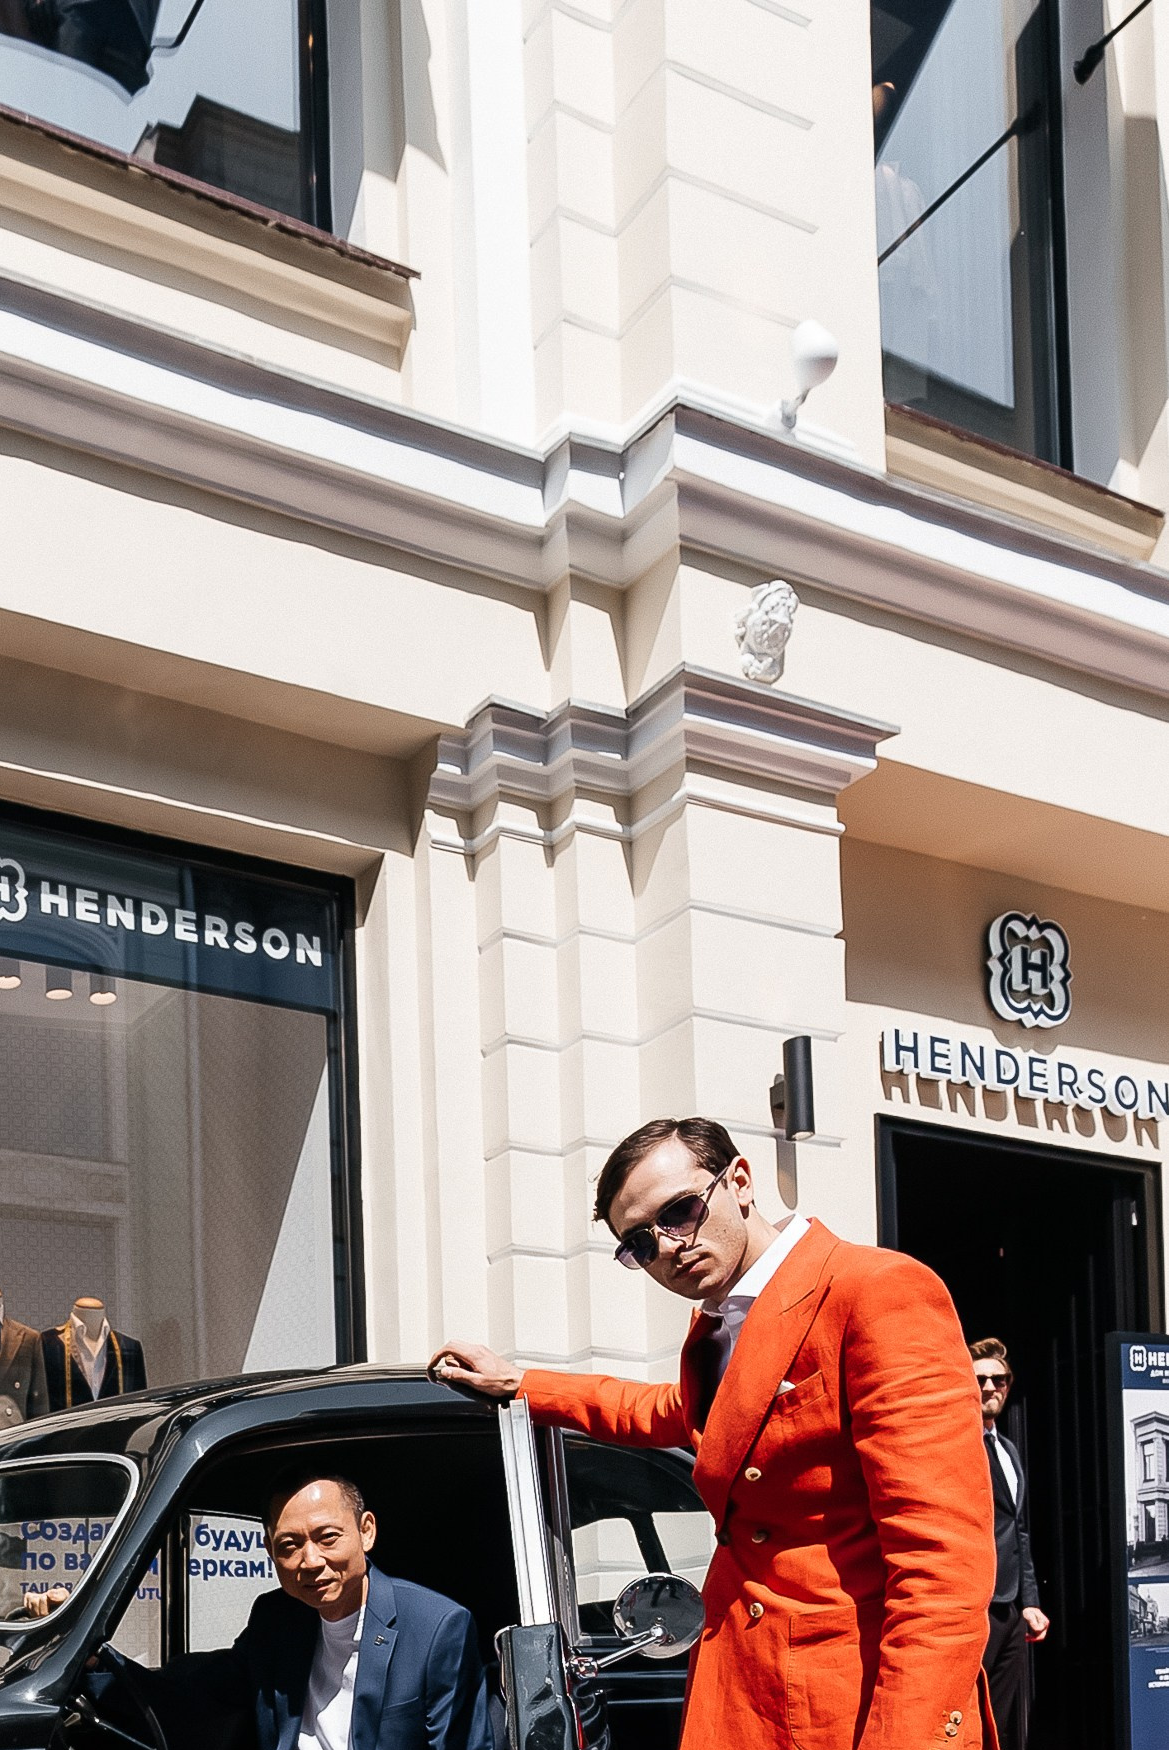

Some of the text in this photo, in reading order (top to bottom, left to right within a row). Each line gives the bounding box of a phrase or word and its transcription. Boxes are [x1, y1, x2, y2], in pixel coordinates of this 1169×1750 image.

[40, 880, 323, 967] HENDERSON
[889, 1028, 1169, 1119] HENDERSON
[21, 1552, 56, 1571] по
[188, 1556, 274, 1581] еркам!
